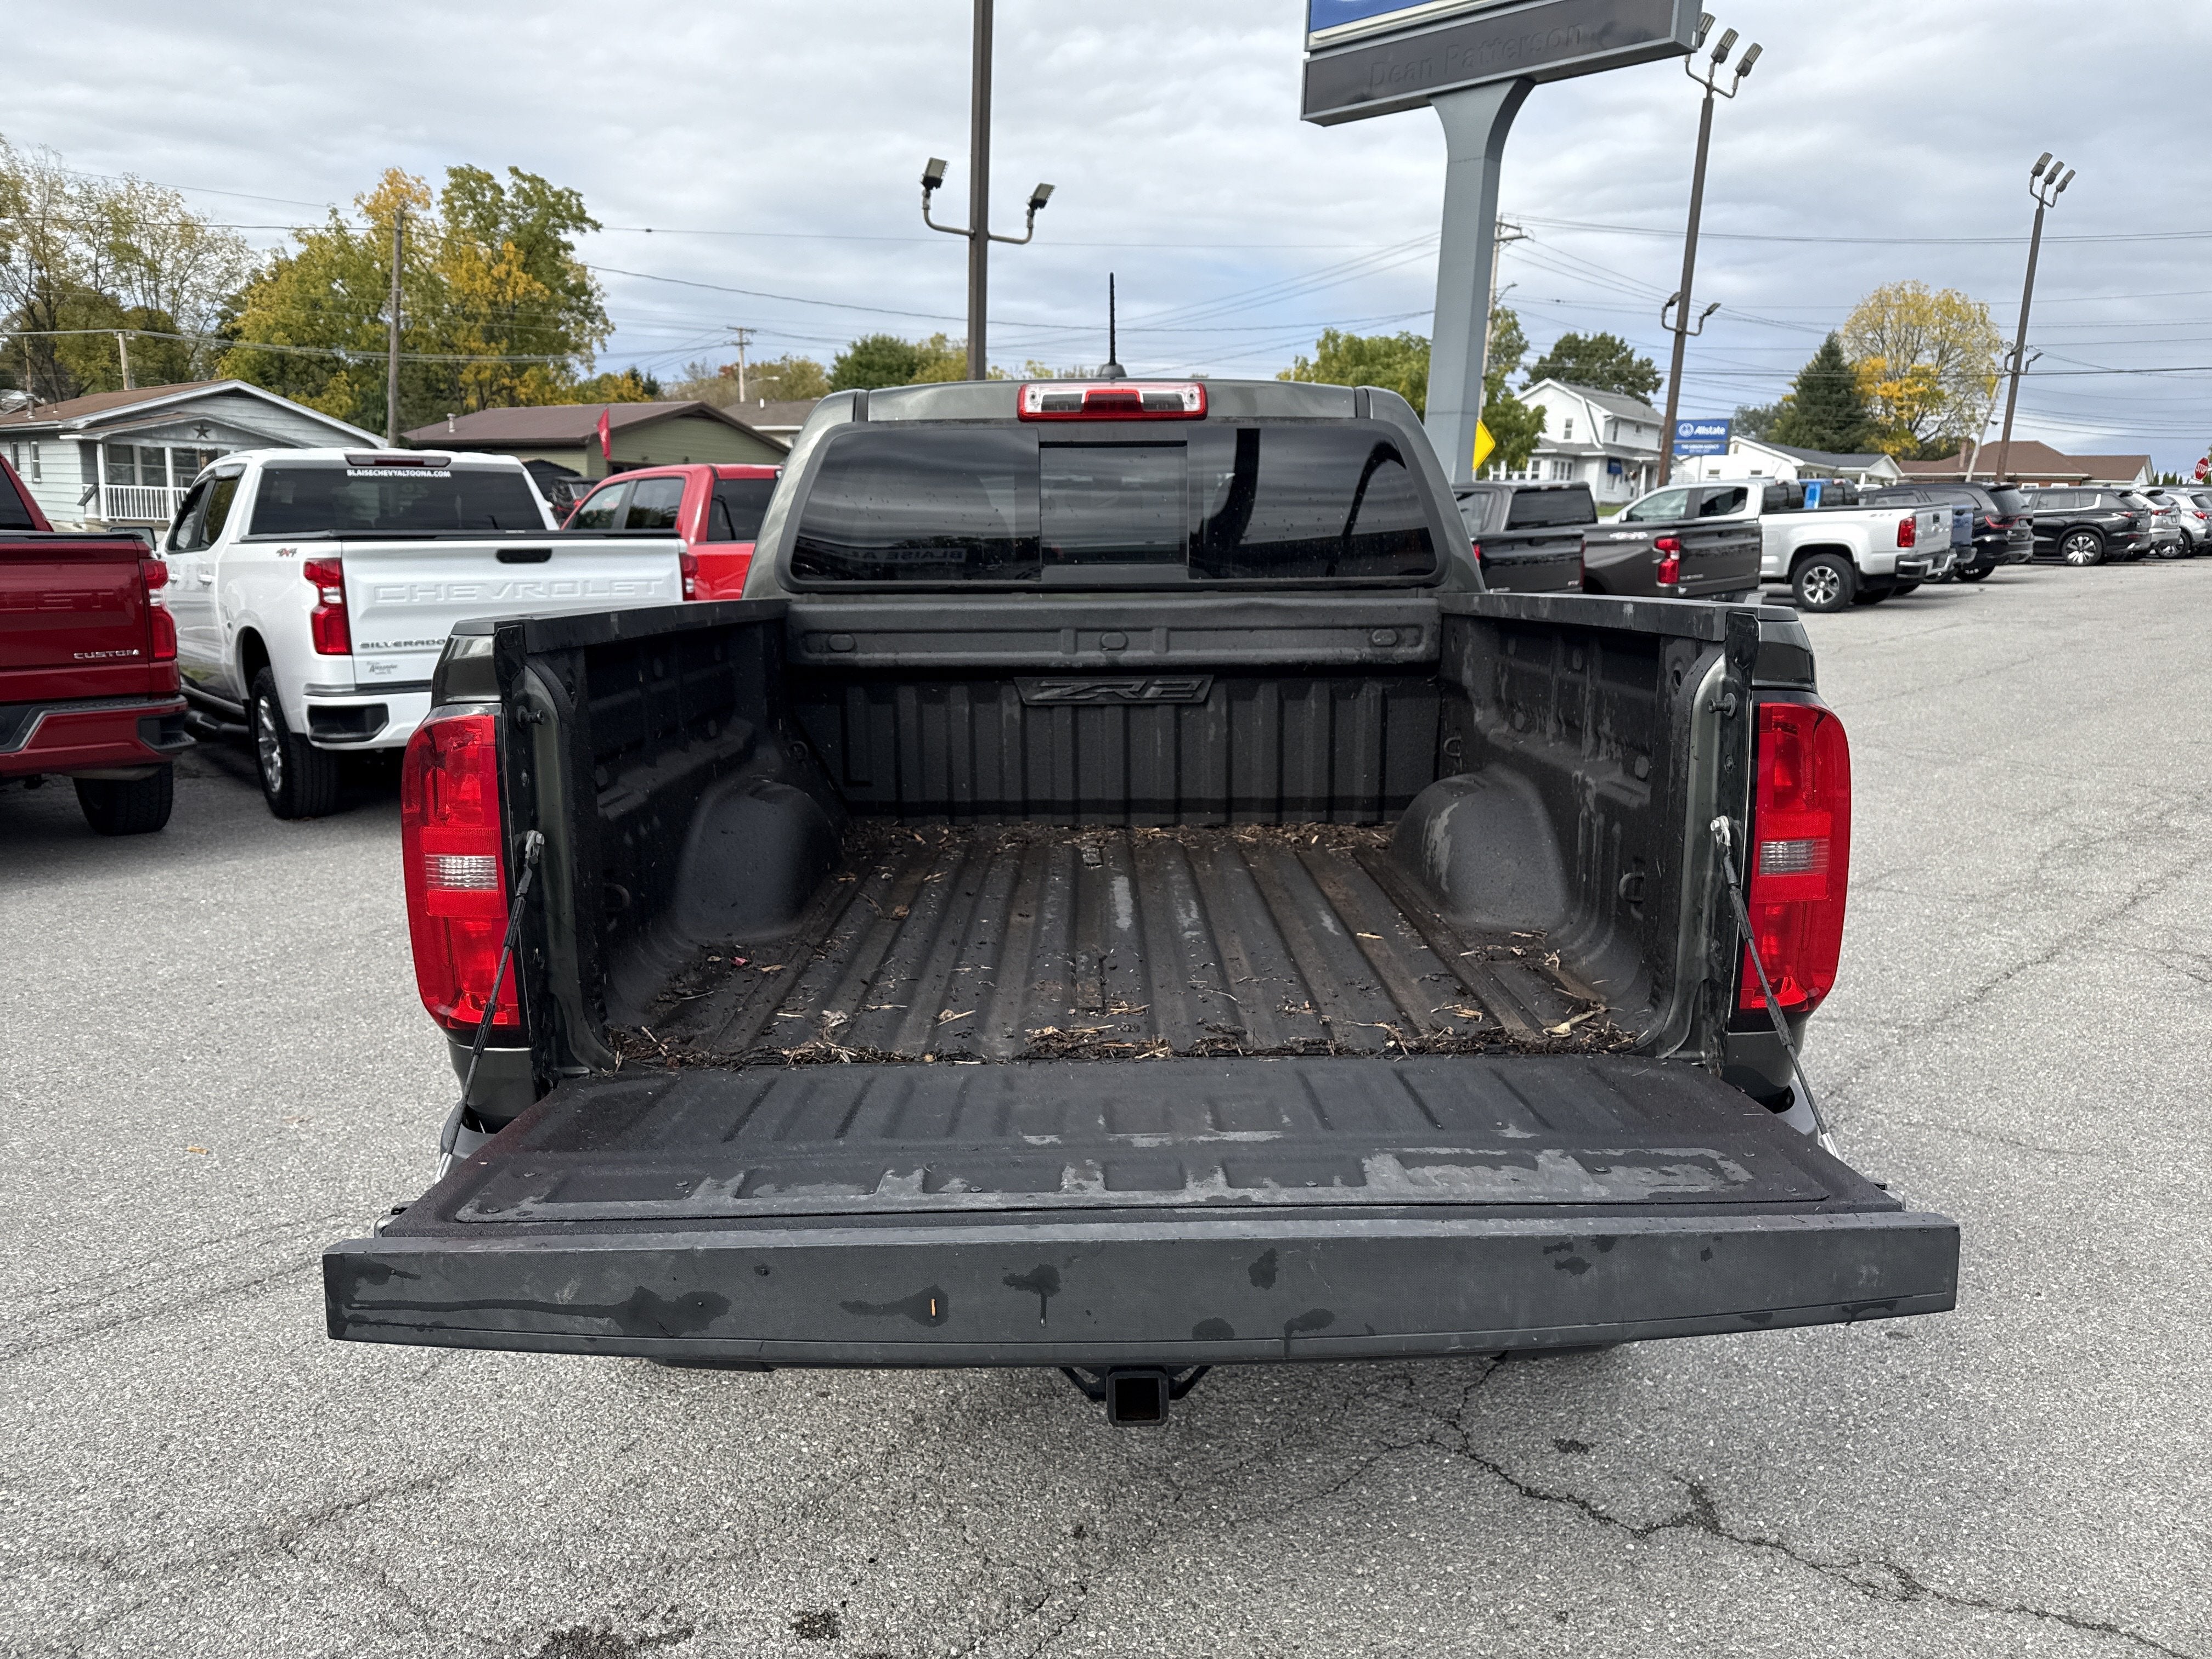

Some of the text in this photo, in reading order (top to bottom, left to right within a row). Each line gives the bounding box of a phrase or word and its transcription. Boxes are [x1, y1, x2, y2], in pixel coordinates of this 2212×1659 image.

[1369, 23, 1583, 90] Dean Patterson
[1694, 426, 1725, 435] Allstate
[2196, 463, 2208, 474] STOP
[374, 579, 664, 602] CHEVROLET
[359, 639, 445, 648] SILVERADO
[74, 649, 140, 659] CUSTOM
